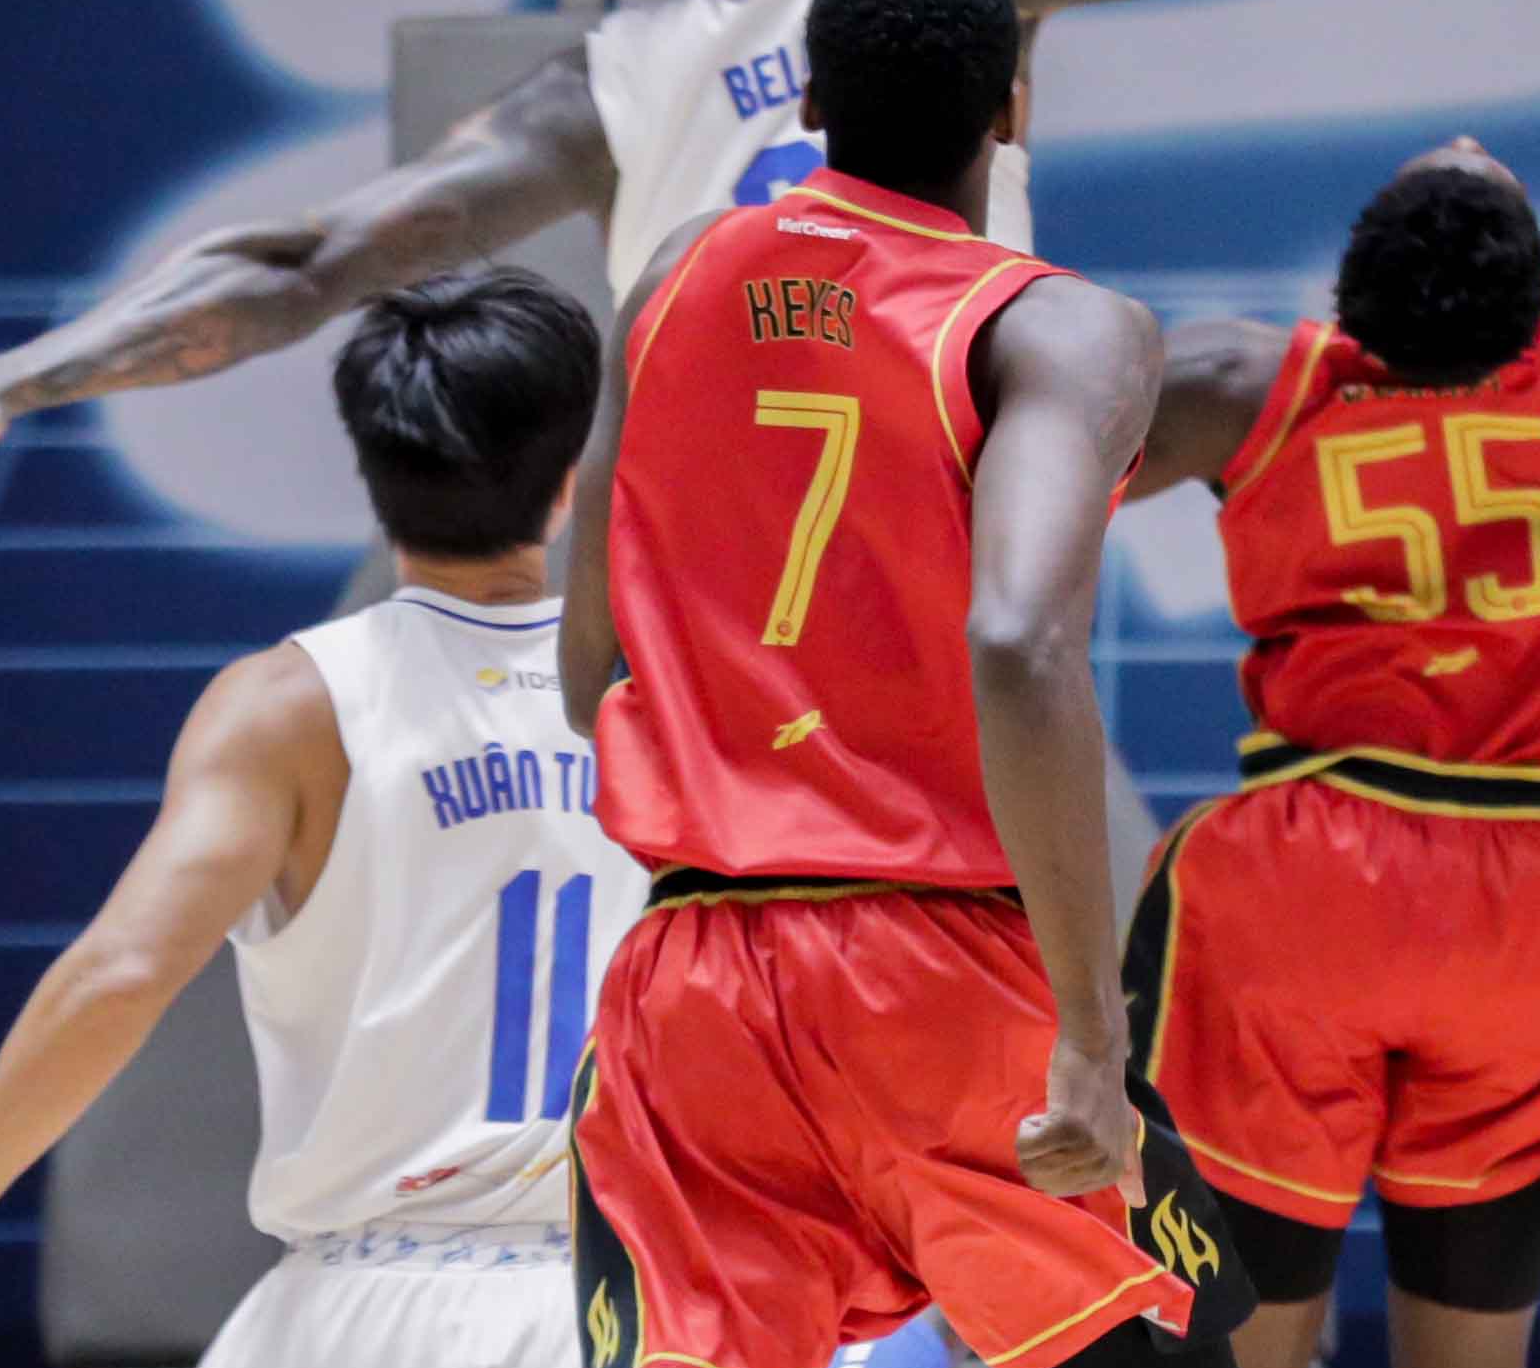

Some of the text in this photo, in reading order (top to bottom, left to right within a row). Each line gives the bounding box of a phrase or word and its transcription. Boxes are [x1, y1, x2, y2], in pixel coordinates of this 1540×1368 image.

[721, 45, 810, 121] BEL
[745, 276, 856, 350] KEYES
[755, 390, 860, 647] 7
[485, 869, 593, 1123] 11
